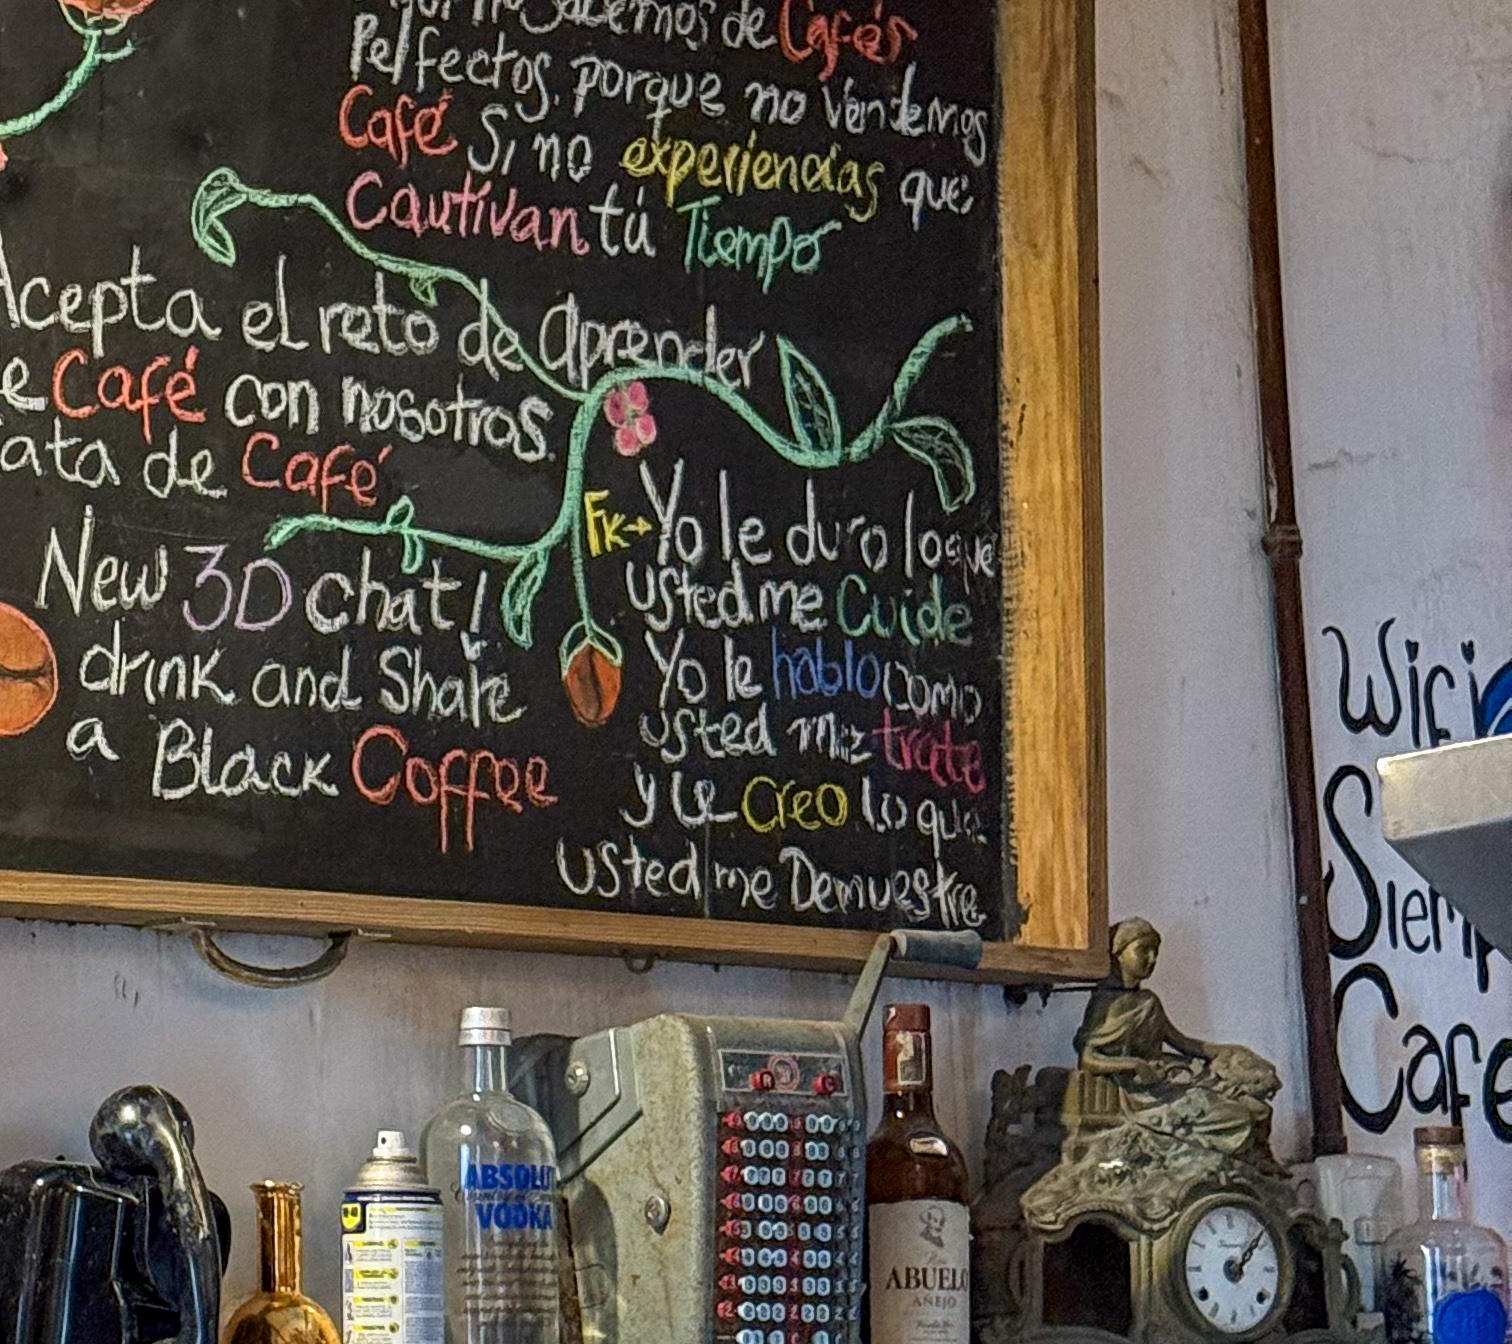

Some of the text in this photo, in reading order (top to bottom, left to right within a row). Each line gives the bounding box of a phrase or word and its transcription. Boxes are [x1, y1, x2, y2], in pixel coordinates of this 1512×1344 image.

[570, 56, 726, 140] porque
[743, 78, 808, 127] no
[338, 83, 459, 170] Café
[532, 132, 593, 183] no
[620, 129, 885, 223] experiencias
[589, 182, 656, 257] tú
[676, 196, 843, 295] Tiempo
[320, 270, 439, 356] reto
[458, 276, 524, 381] de
[51, 344, 208, 445] Café
[224, 373, 319, 435] con
[143, 424, 228, 500] de
[240, 430, 393, 514] Café
[639, 458, 703, 566] Yo
[719, 469, 774, 566] le
[788, 478, 887, 573] duro
[34, 504, 168, 617] New
[183, 543, 292, 632] 3D
[759, 580, 827, 633] me
[837, 572, 973, 646] Cuide
[79, 619, 527, 729] drink and Share
[644, 628, 707, 708] Yo
[724, 634, 762, 702] le
[771, 626, 882, 699] hablo
[66, 716, 559, 854] a Black Coffee
[871, 708, 986, 793] trate
[740, 775, 849, 834] Creo
[714, 861, 777, 911] me
[475, 1203, 552, 1229] VODKA
[885, 1266, 968, 1291] ABUELO
